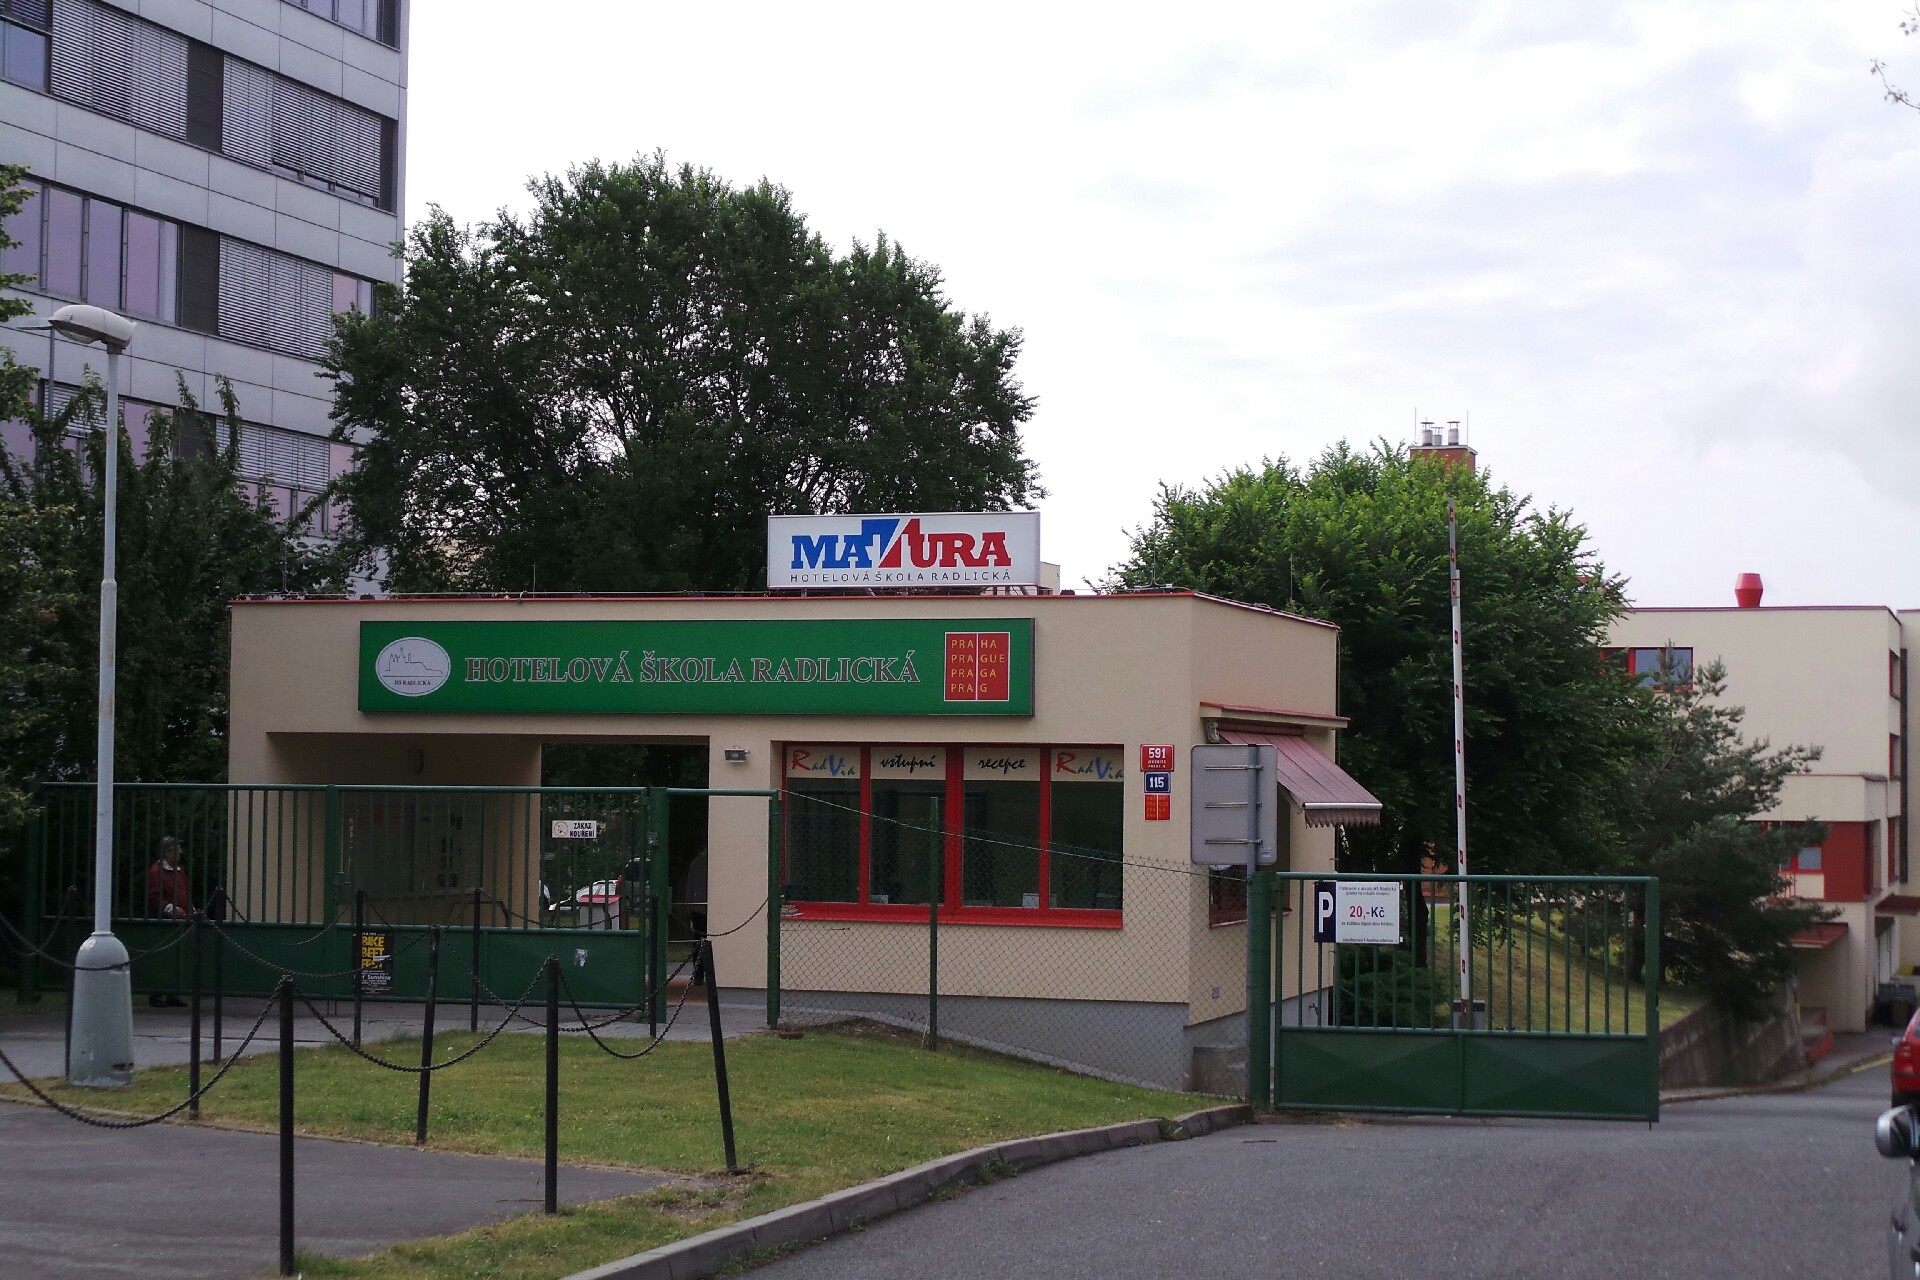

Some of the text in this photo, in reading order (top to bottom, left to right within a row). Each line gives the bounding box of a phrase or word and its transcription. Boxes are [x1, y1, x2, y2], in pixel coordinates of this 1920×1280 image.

[790, 518, 1012, 569] MATURA
[790, 569, 1011, 583] HOTELOVÁ ŠKOLA RADLICKÁ
[464, 650, 921, 683] HOTELOVÁ ŠKOLA RADLICKÁ
[1148, 747, 1166, 759] 591
[880, 753, 1026, 775] vstupní recepce
[1149, 776, 1165, 788] 115
[1318, 892, 1334, 932] P
[361, 936, 385, 947] BIKE
